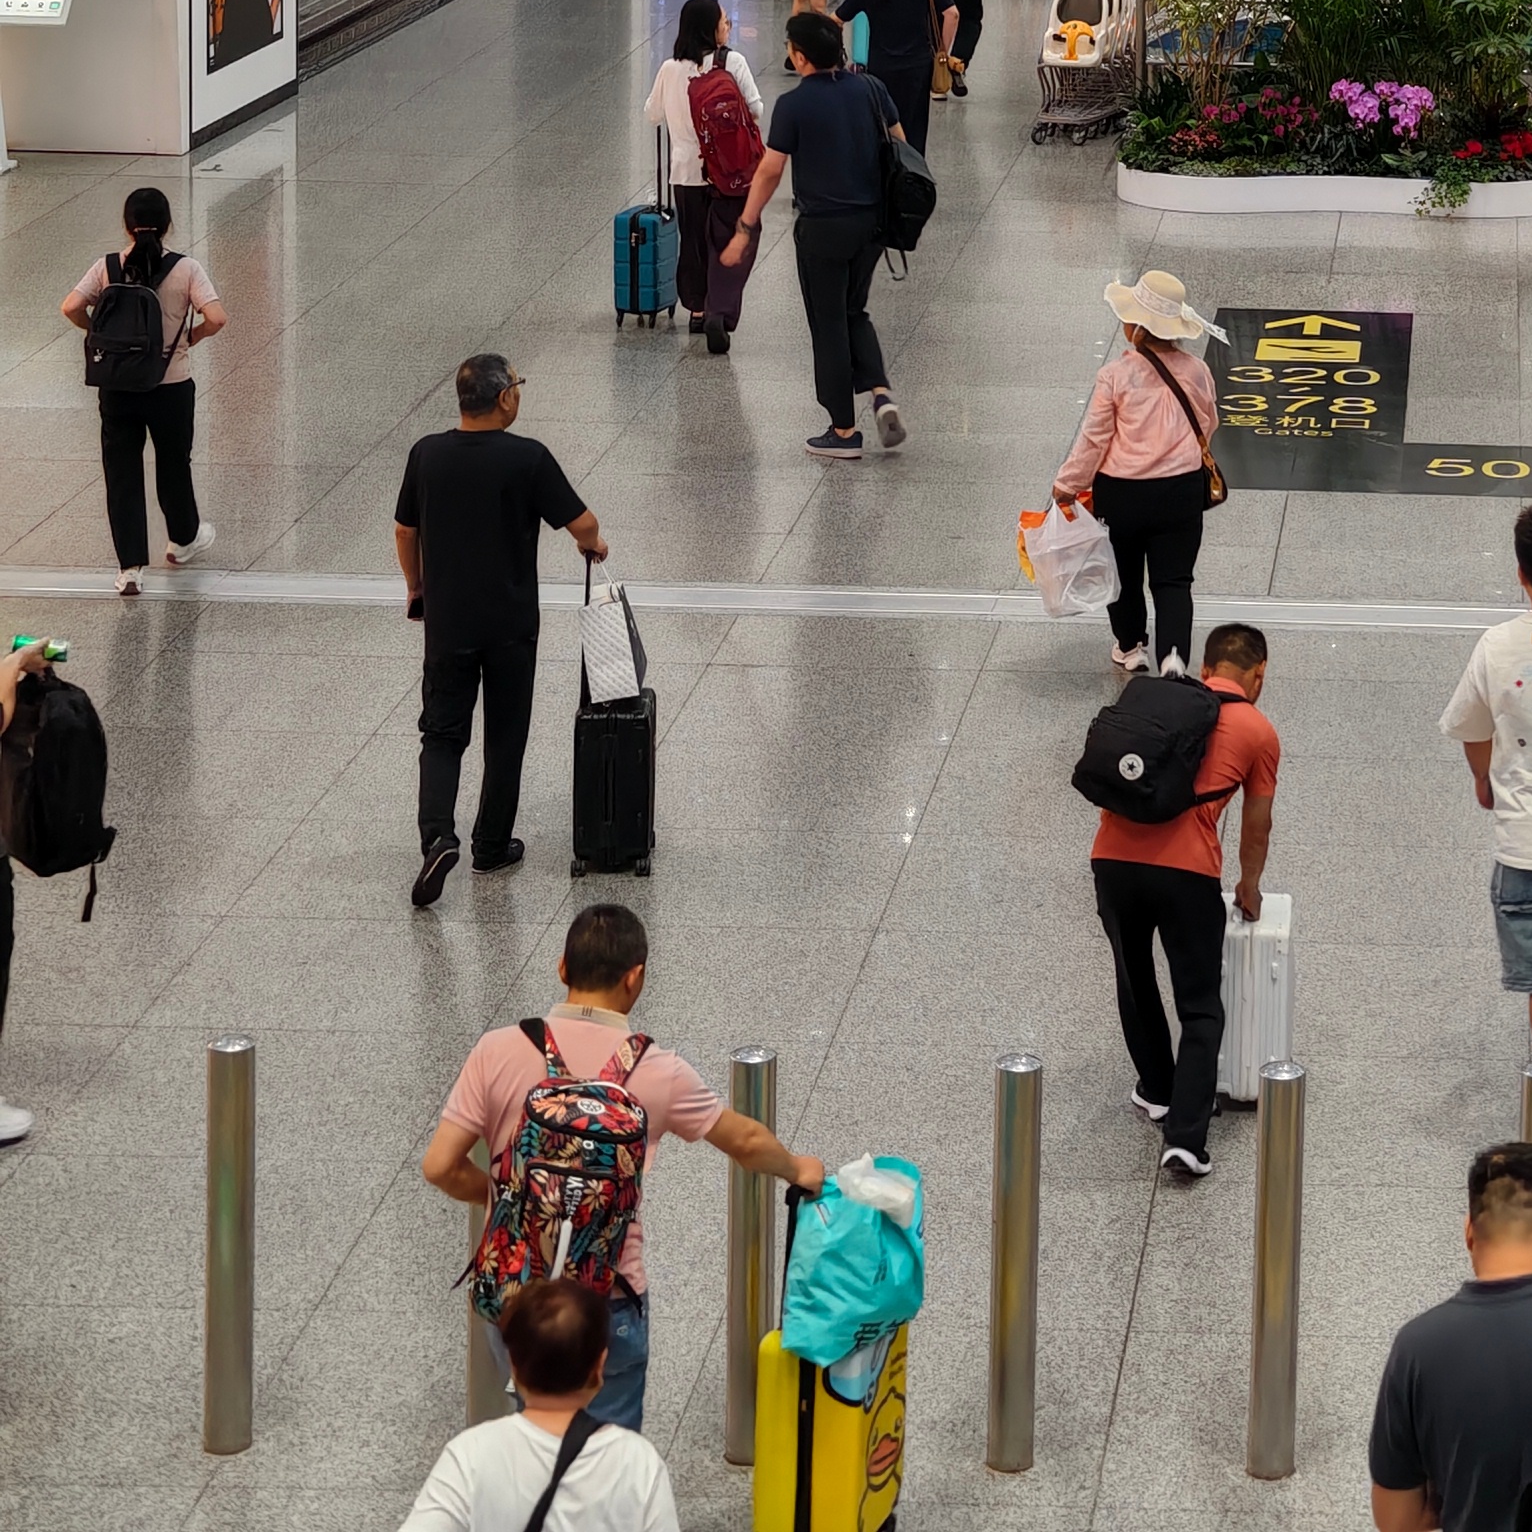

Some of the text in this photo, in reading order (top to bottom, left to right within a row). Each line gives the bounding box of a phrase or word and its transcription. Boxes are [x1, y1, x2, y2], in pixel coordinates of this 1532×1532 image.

[1227, 366, 1381, 385] 320
[1219, 394, 1378, 415] 378
[1222, 414, 1370, 429] 登机口
[1254, 428, 1334, 437] Gates
